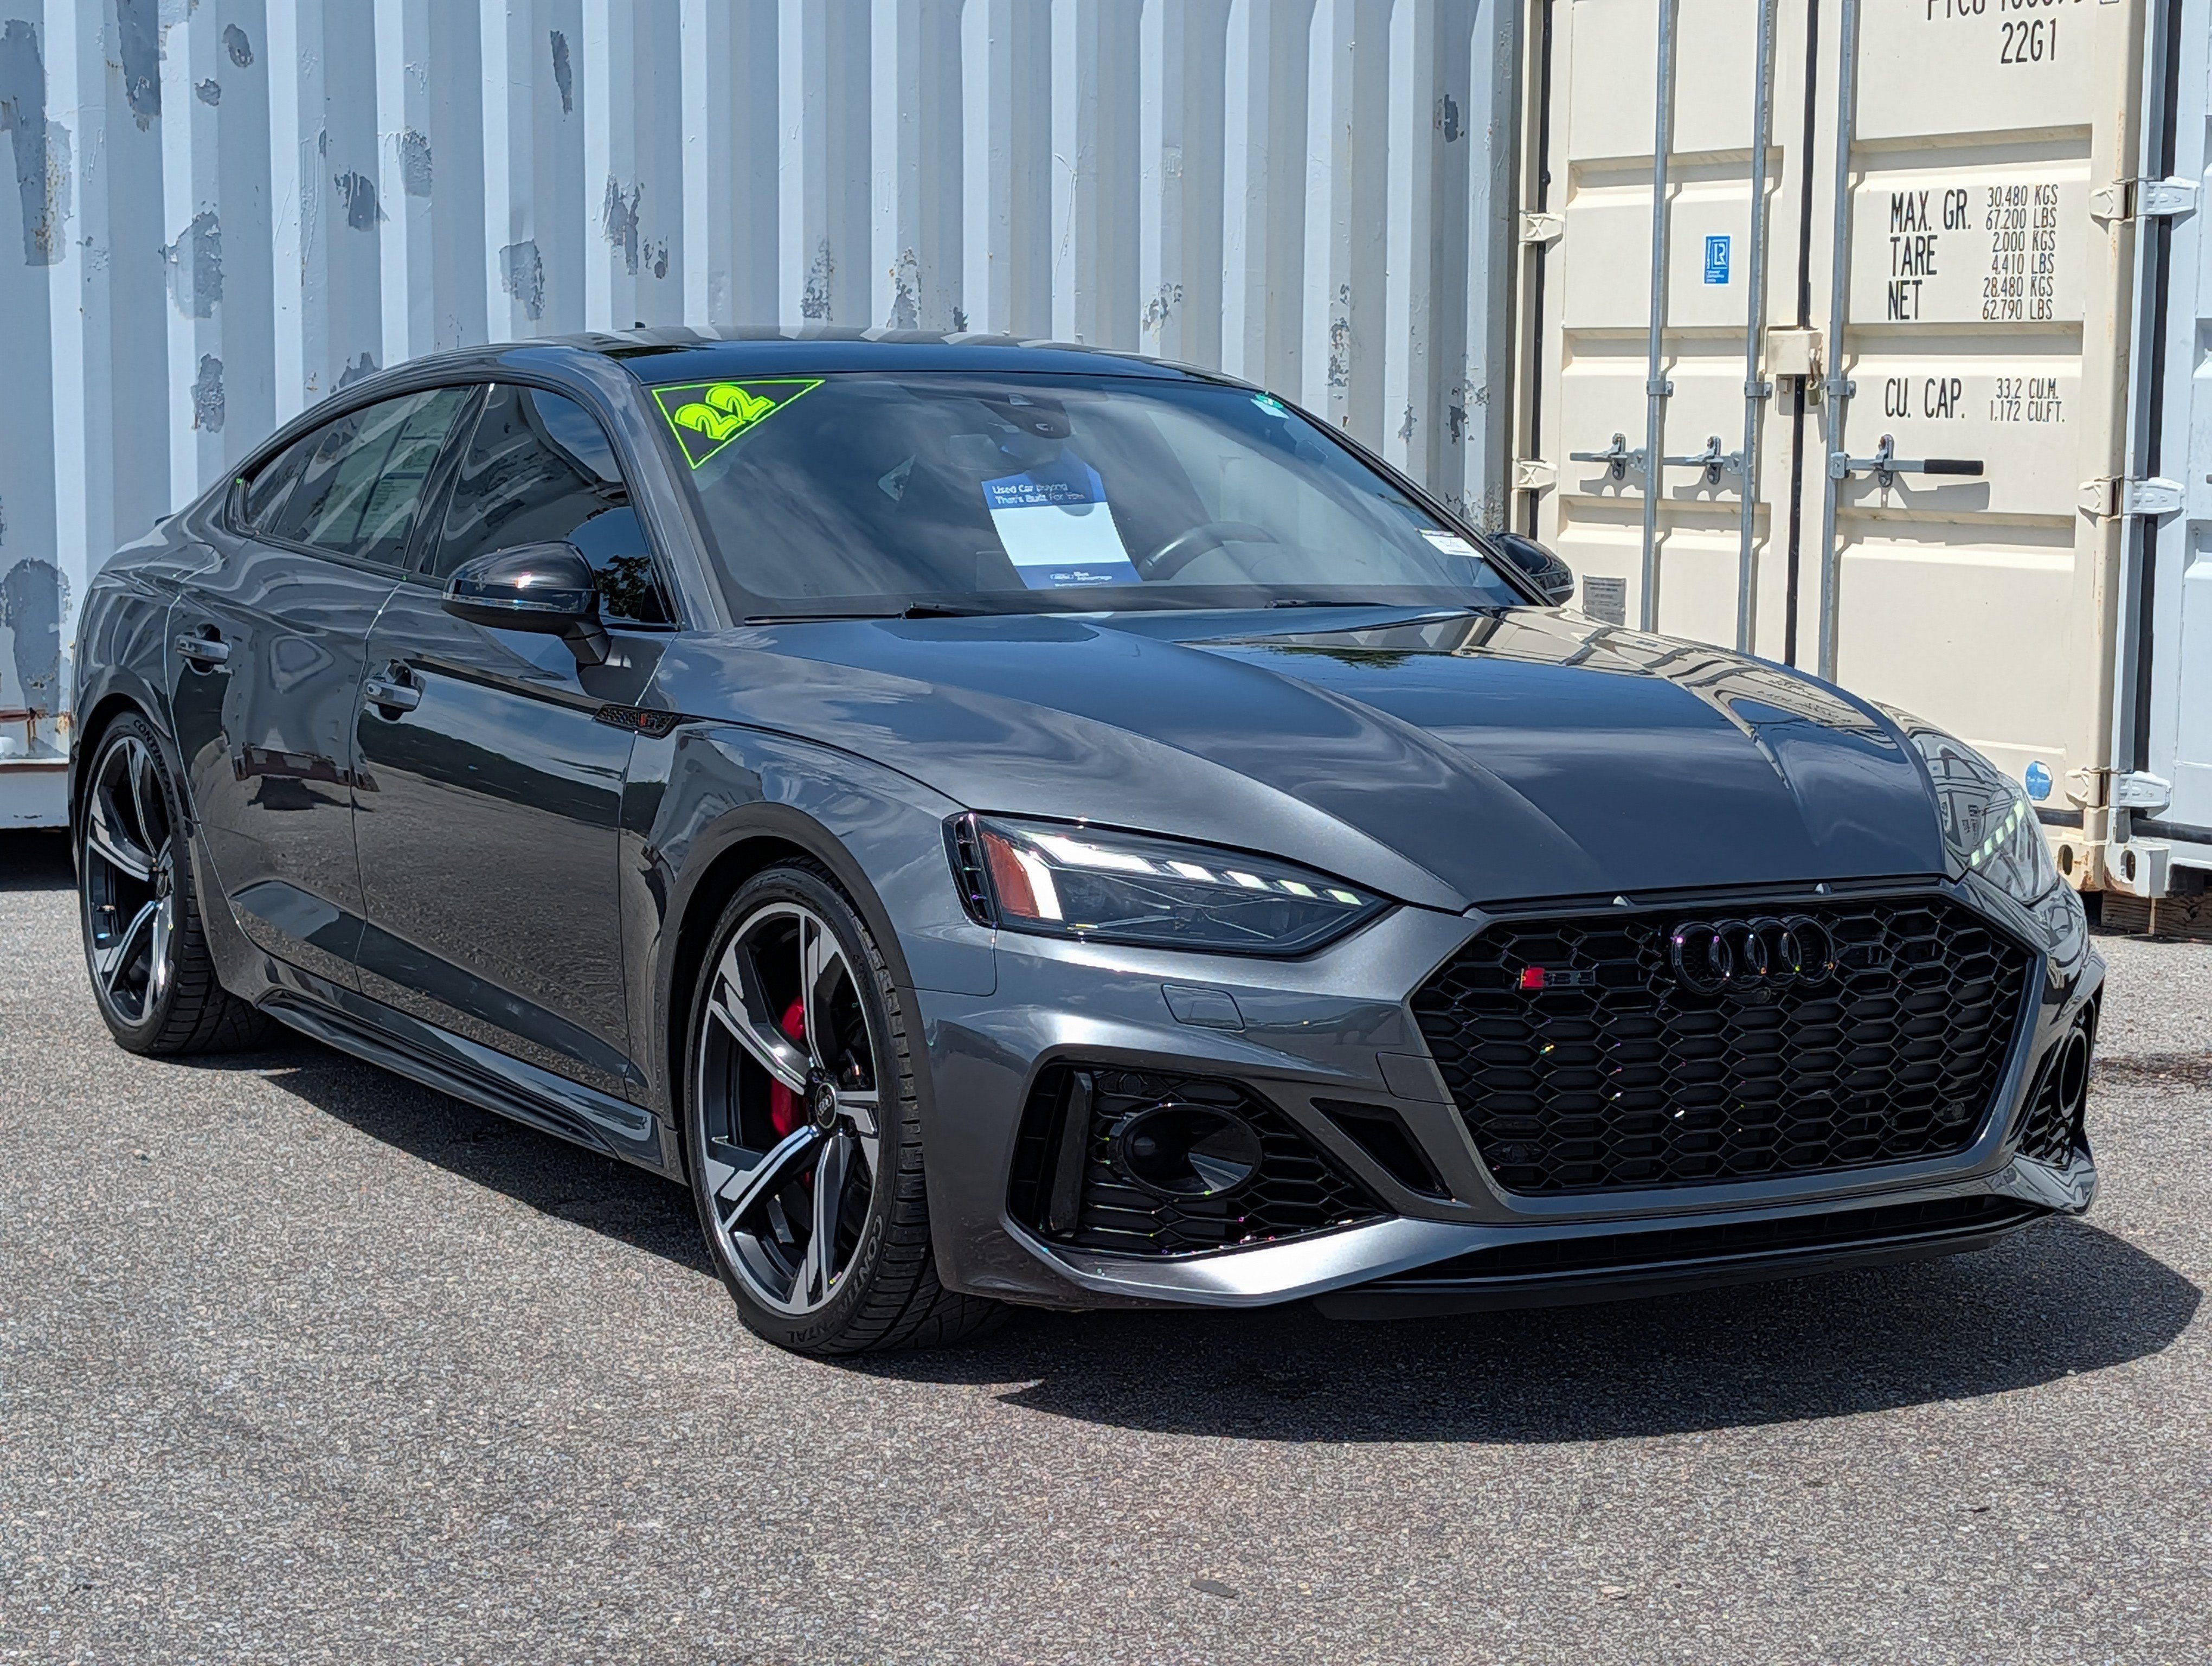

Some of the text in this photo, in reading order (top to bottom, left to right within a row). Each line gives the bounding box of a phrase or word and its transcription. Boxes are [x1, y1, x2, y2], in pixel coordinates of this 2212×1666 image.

[2001, 18, 2056, 63] 22G1
[1890, 190, 1932, 233] MAX.
[1943, 189, 1971, 230] GR.
[2034, 184, 2059, 206] KGS
[2033, 207, 2057, 228] LBS
[1889, 234, 1938, 277] TARE
[2032, 230, 2056, 251] KGS
[2031, 253, 2054, 274] LBS
[1888, 279, 1923, 321] NET
[2030, 275, 2054, 297] KGS
[2029, 298, 2053, 320] LBS
[674, 385, 776, 440] 22
[1885, 378, 1911, 418] CU.
[1924, 378, 1965, 418] CAP.
[1996, 378, 2022, 399] 33.2
[1990, 400, 2021, 421] 1,172
